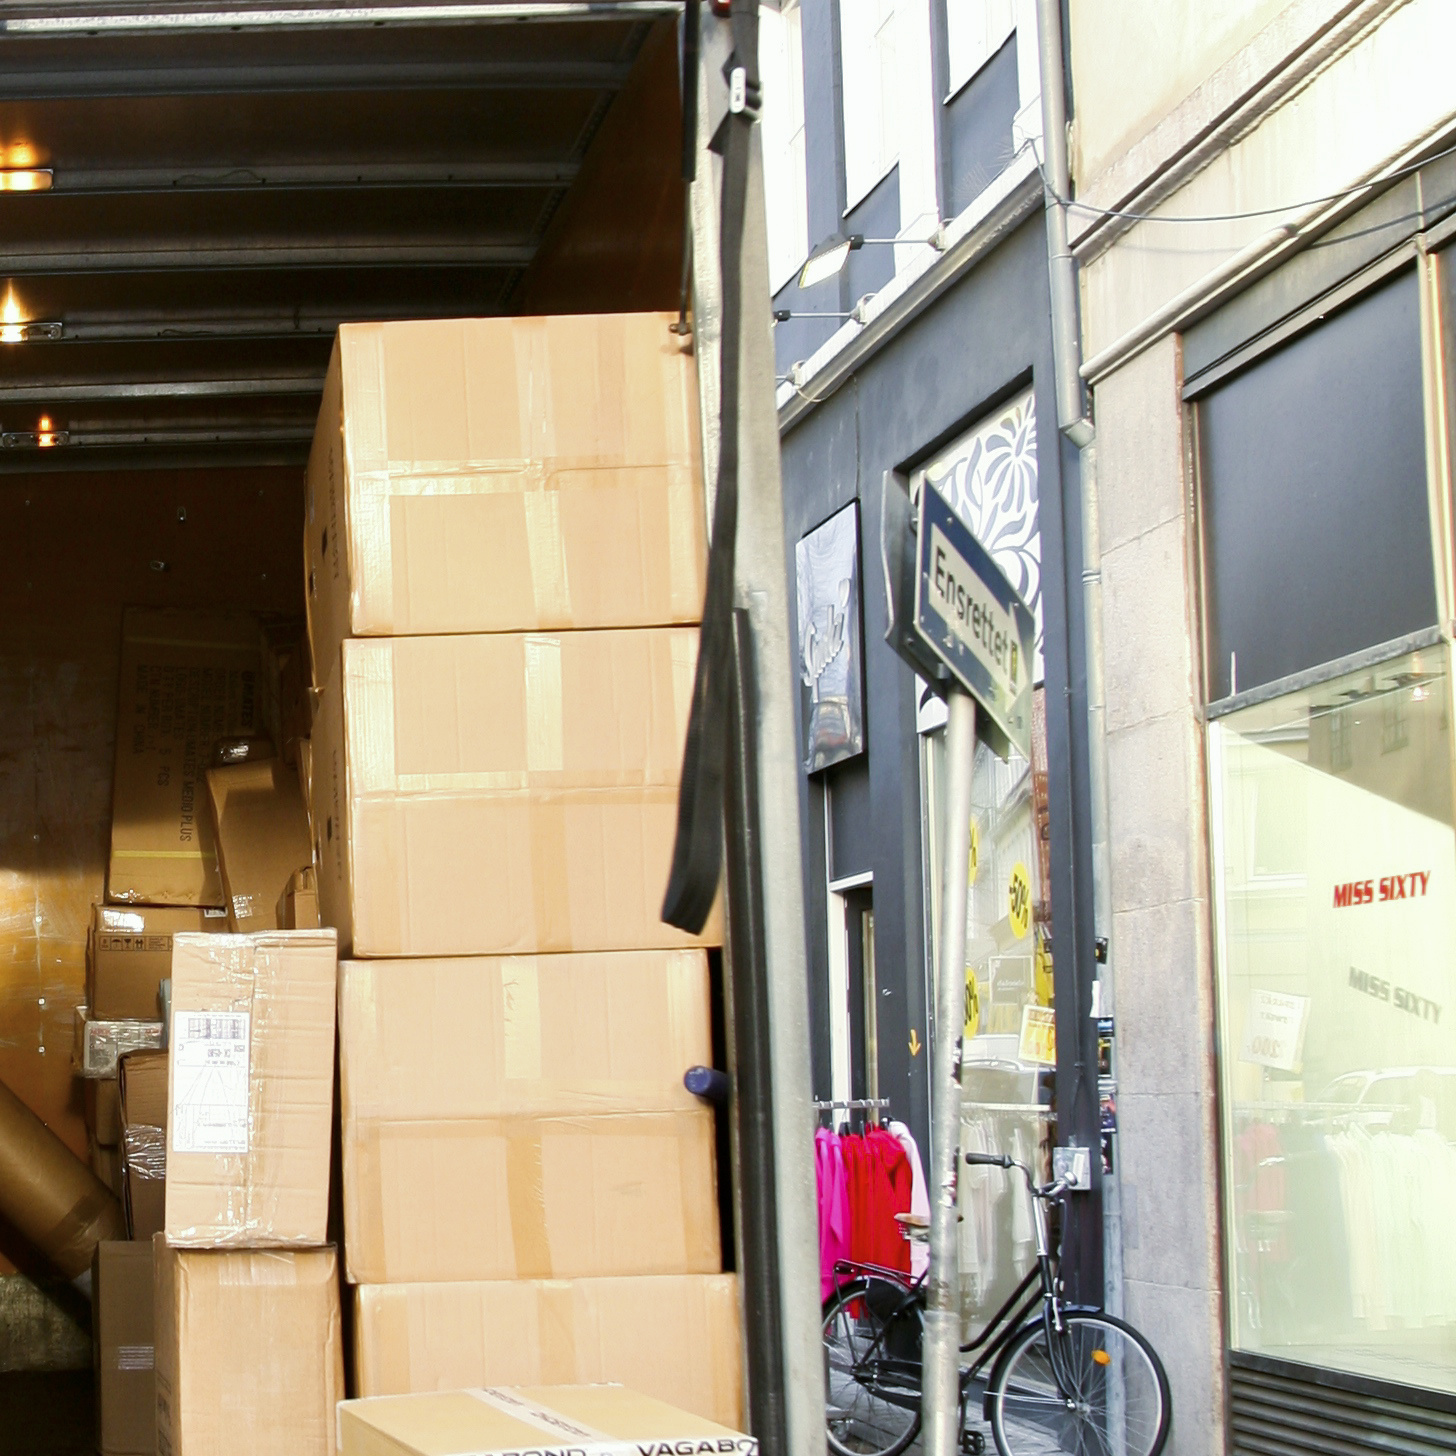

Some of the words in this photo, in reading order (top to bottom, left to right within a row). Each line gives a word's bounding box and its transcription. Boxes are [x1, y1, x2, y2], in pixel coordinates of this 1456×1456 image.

[934, 545, 1008, 674] Ensrettet
[180, 781, 193, 812] MEDIO
[178, 814, 192, 842] PLUS
[1333, 879, 1374, 908] MISS
[1379, 870, 1431, 902] SIXTY
